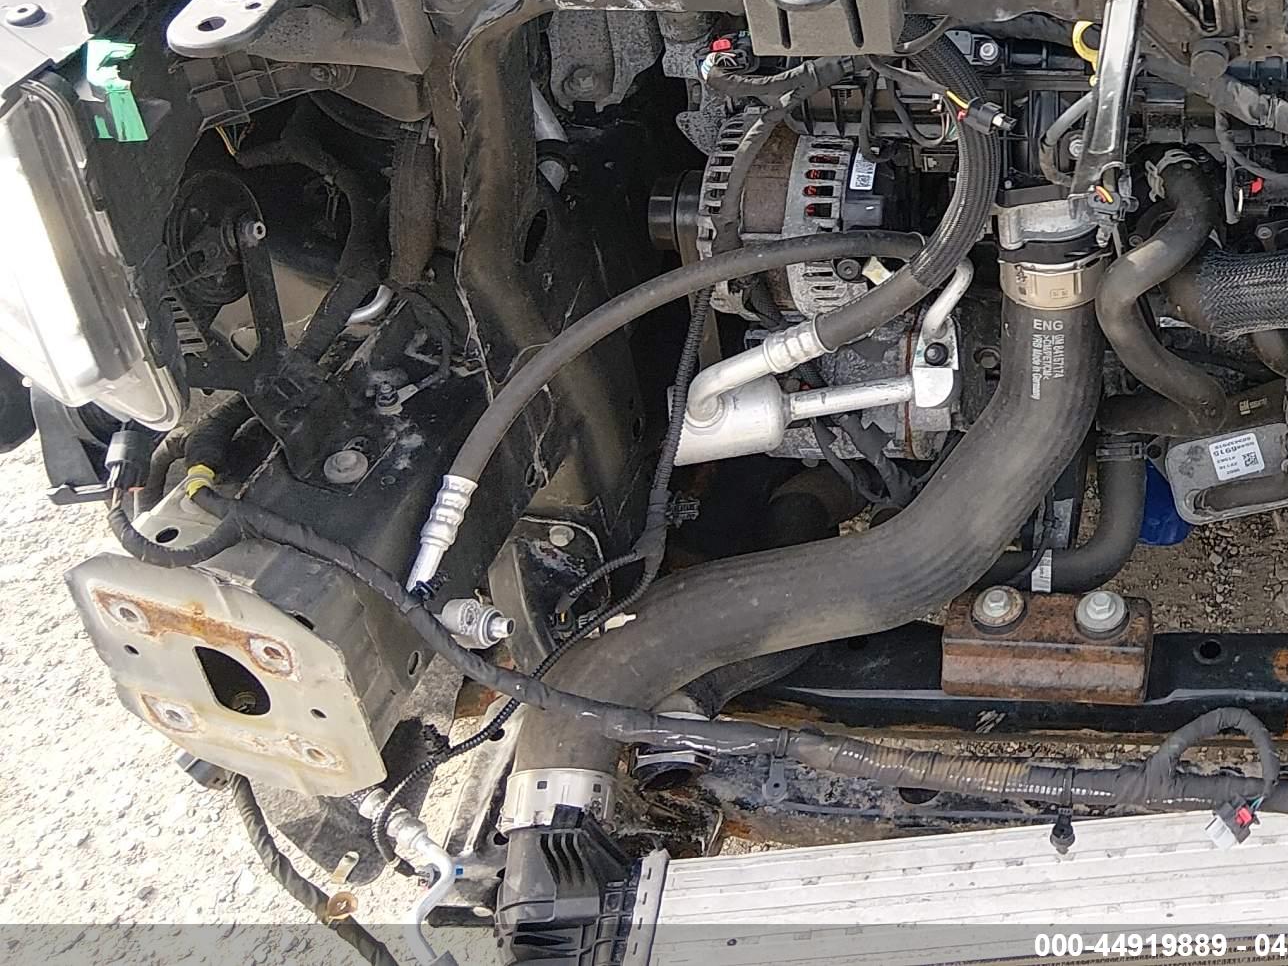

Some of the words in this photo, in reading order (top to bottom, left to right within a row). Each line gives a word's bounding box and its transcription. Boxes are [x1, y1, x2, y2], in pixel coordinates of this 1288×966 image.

[1033, 318, 1064, 331] ENG
[1032, 348, 1043, 365] Made
[1030, 373, 1042, 401] Germany
